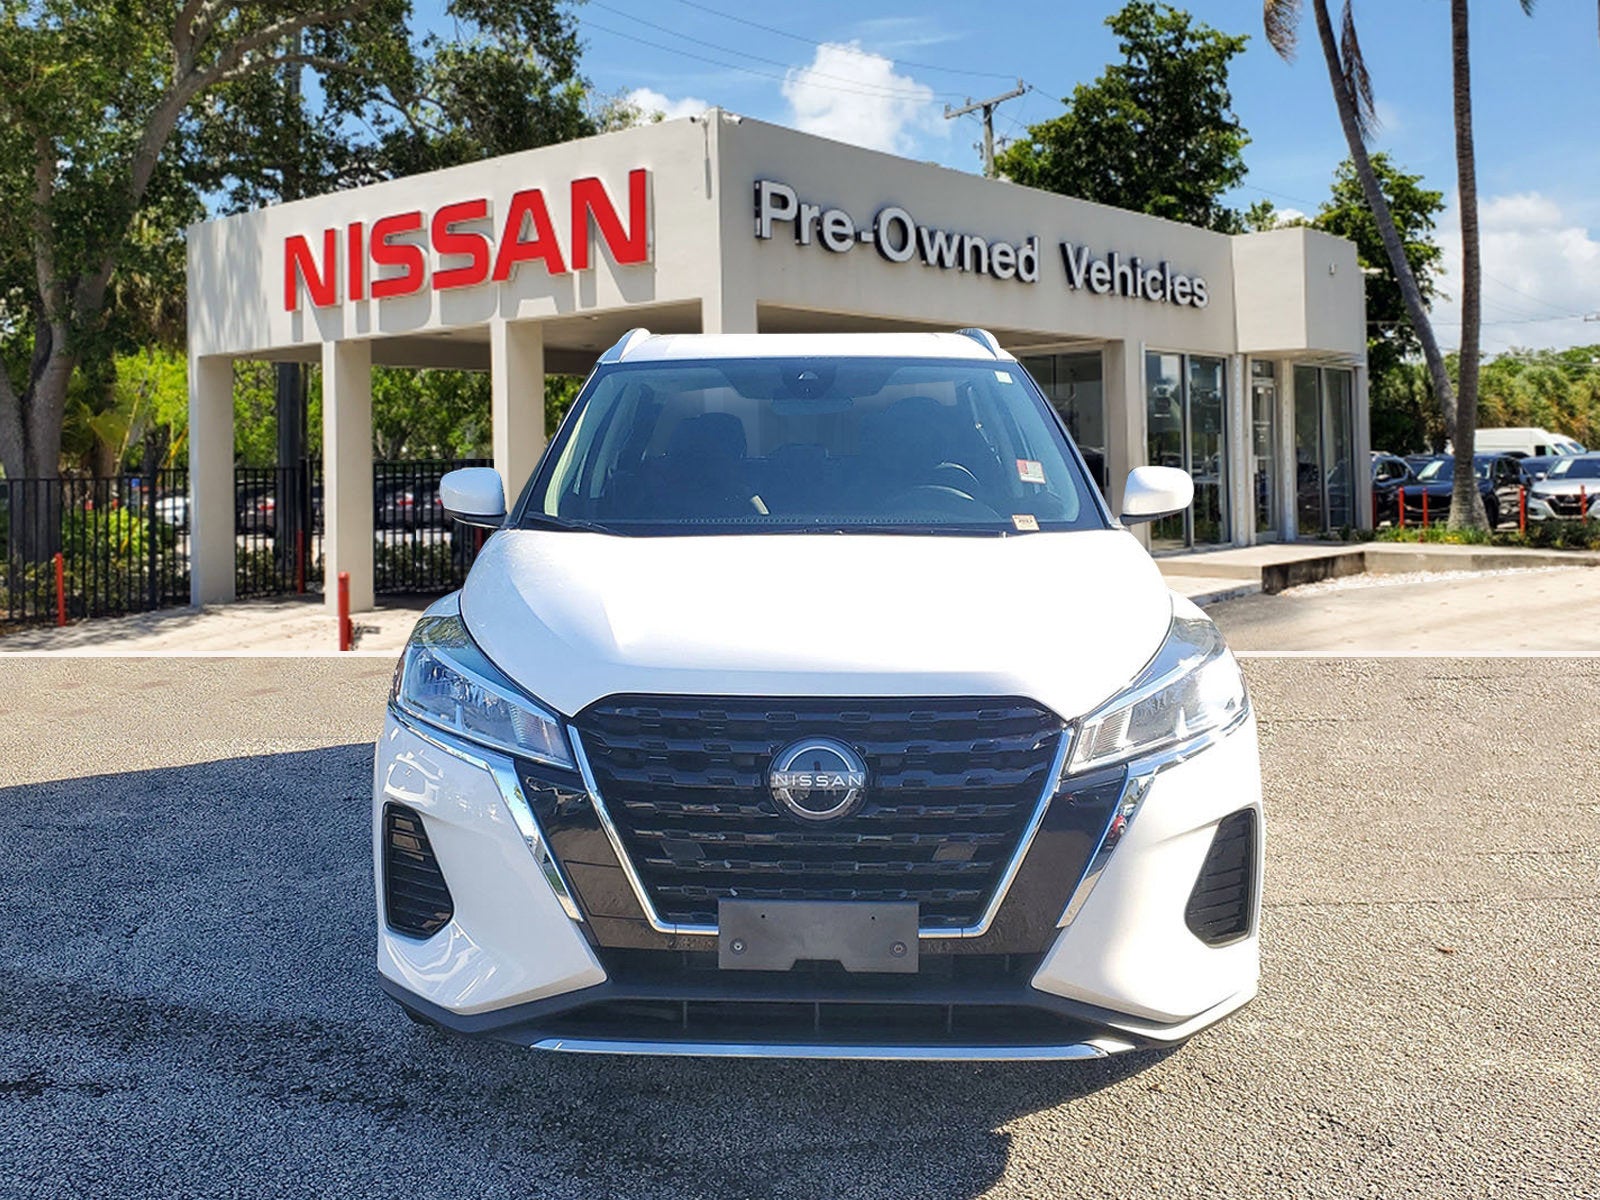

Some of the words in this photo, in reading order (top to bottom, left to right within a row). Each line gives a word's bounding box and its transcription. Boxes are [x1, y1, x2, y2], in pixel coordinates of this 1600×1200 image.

[284, 168, 647, 312] NISSAN
[755, 179, 1041, 284] Pre-Owned
[1060, 241, 1209, 309] Vehicles
[774, 774, 862, 787] NISSAN
